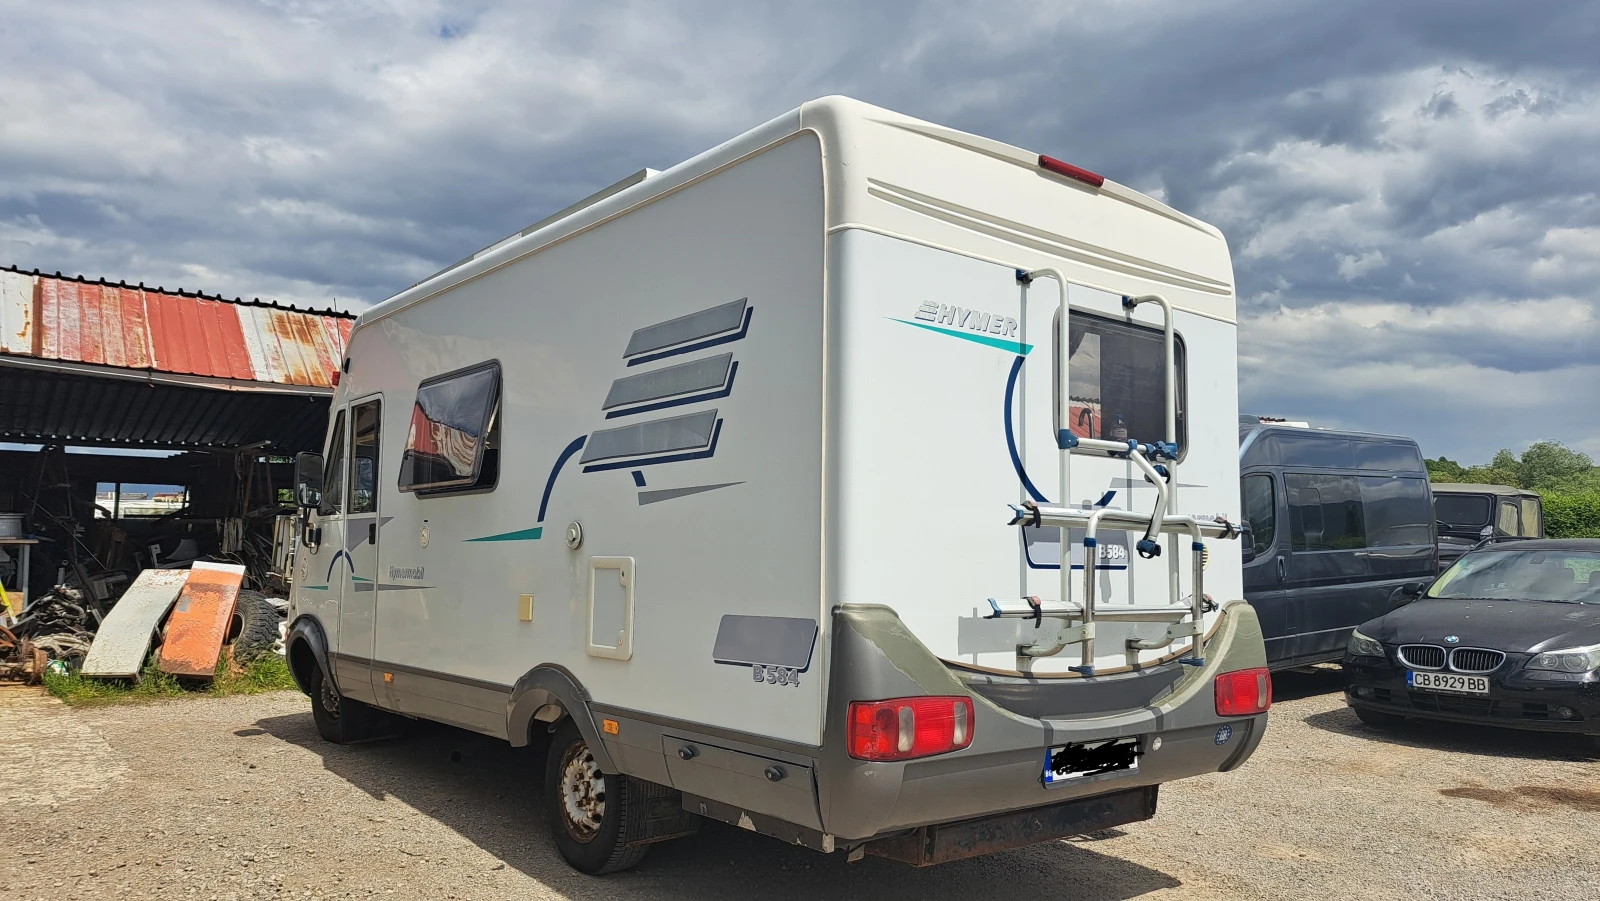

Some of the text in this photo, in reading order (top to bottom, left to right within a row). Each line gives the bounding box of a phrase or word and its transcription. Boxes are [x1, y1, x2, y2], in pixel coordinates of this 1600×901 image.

[937, 303, 1018, 337] HYMER
[1414, 673, 1486, 691] CB 8929 BB
